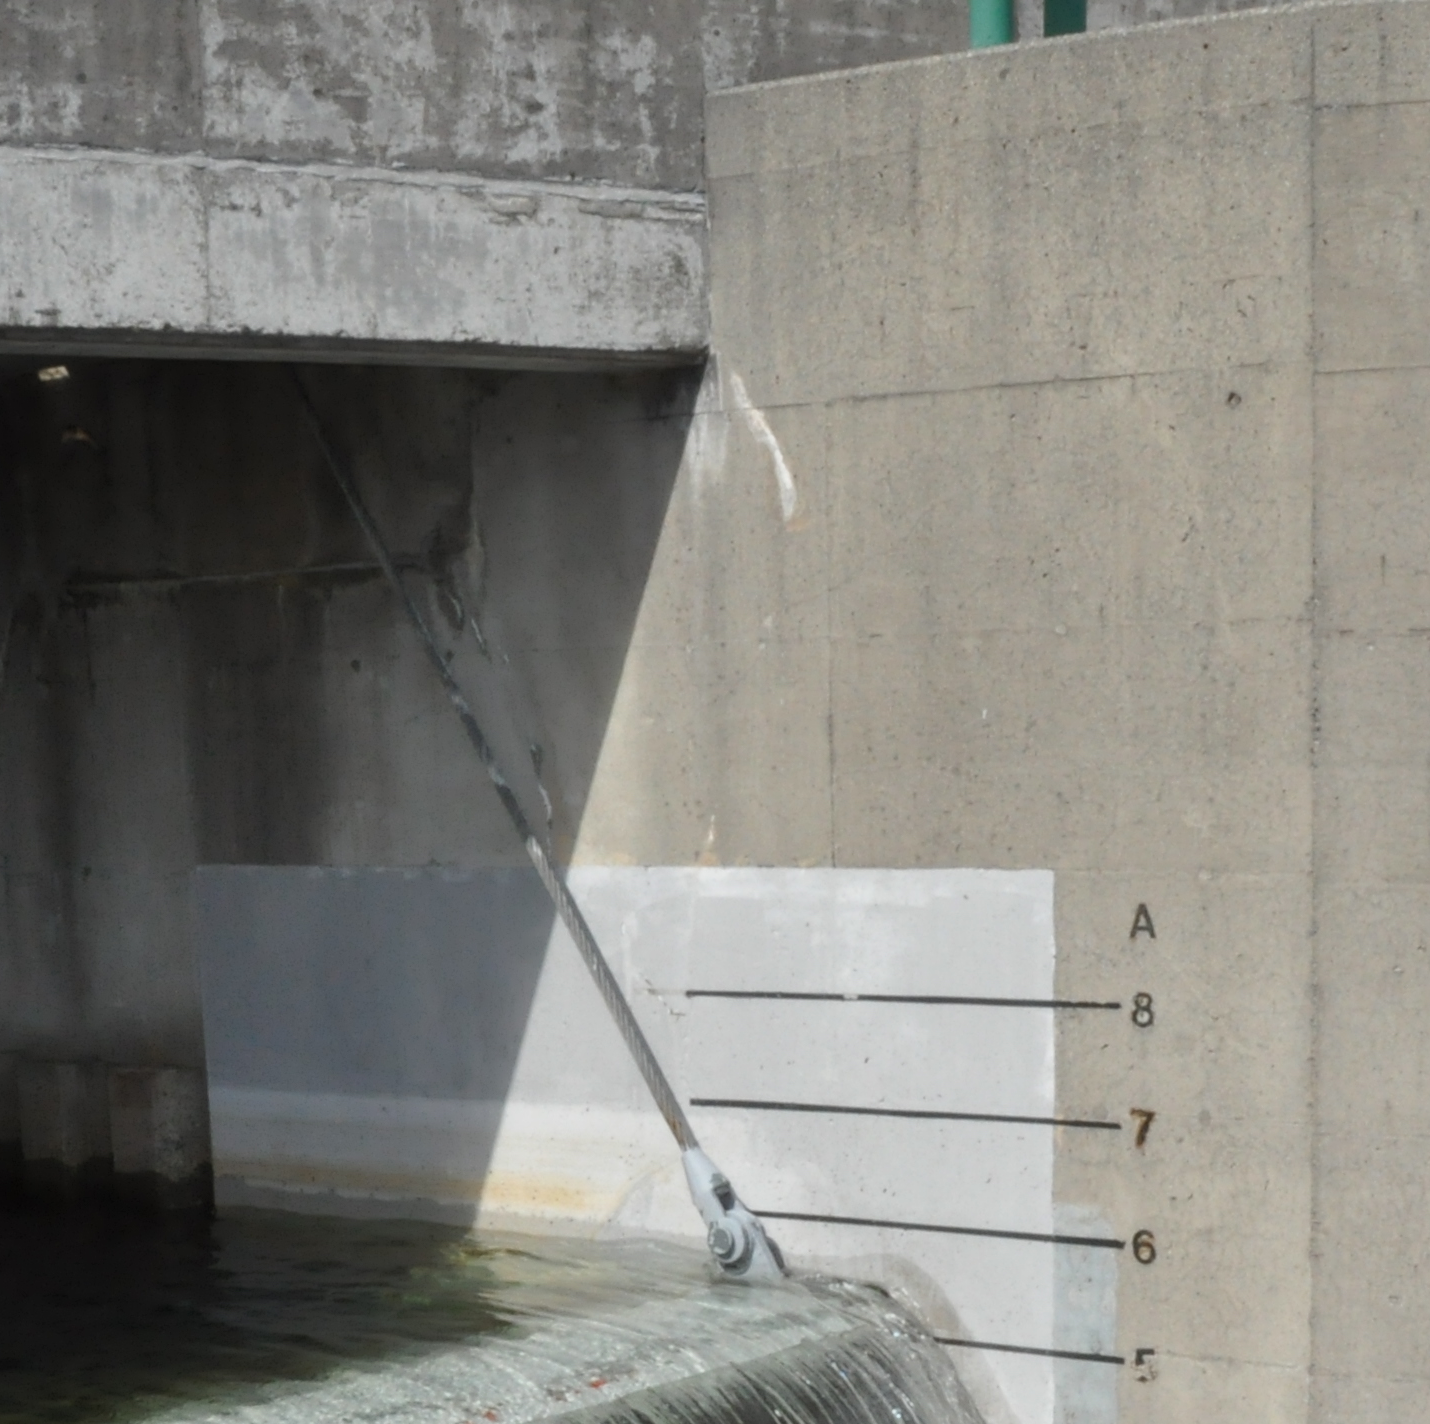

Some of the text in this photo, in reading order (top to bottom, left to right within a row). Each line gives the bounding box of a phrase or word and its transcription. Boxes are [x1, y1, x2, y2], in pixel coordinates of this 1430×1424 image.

[1129, 903, 1156, 938] A
[1131, 992, 1154, 1027] 8
[1130, 1108, 1156, 1147] 7
[1132, 1229, 1157, 1264] 6
[1134, 1348, 1158, 1382] 5
